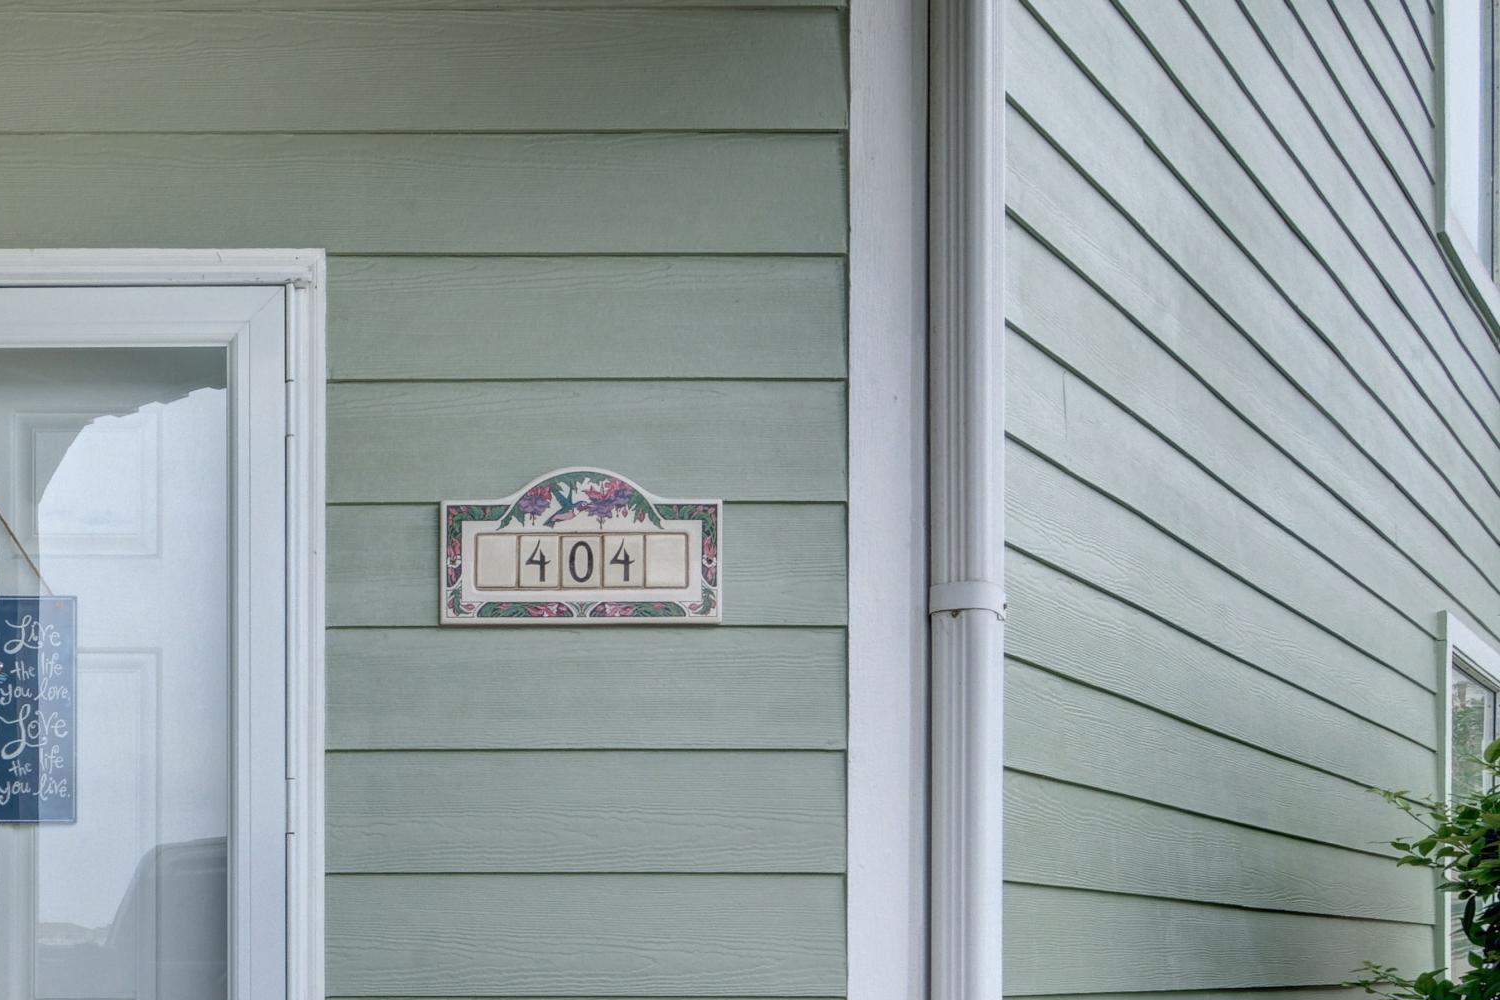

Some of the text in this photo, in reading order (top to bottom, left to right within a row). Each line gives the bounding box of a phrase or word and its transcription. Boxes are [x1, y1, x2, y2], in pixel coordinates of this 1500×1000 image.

[525, 539, 635, 583] 404
[3, 614, 62, 655] Live
[10, 652, 63, 681] the life
[0, 683, 33, 706] you
[8, 744, 65, 777] the life
